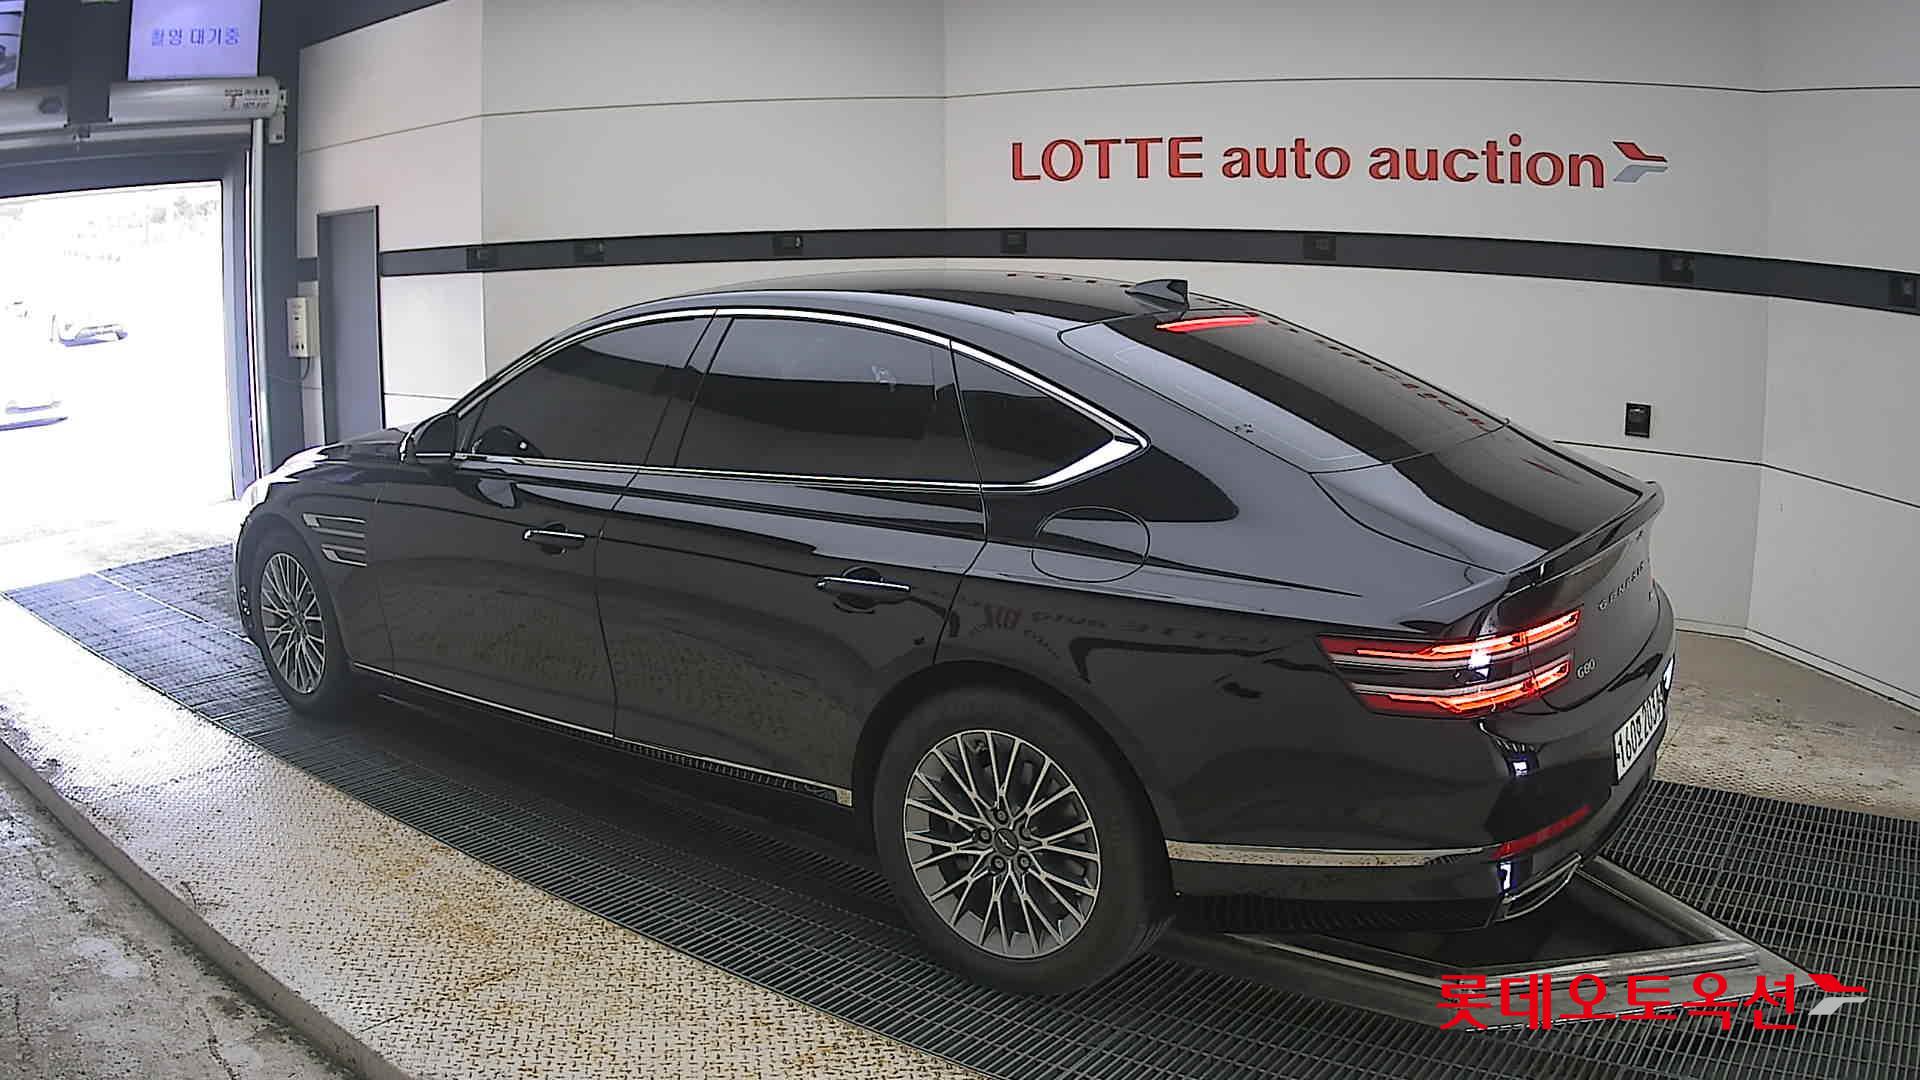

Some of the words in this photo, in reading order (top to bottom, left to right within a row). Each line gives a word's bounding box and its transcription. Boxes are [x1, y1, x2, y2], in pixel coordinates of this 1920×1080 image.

[190, 26, 240, 46] 대기중
[1011, 136, 1203, 182] LOTTE
[1221, 137, 1351, 179] auto
[1368, 134, 1605, 189] auction
[1576, 657, 1596, 680] G80
